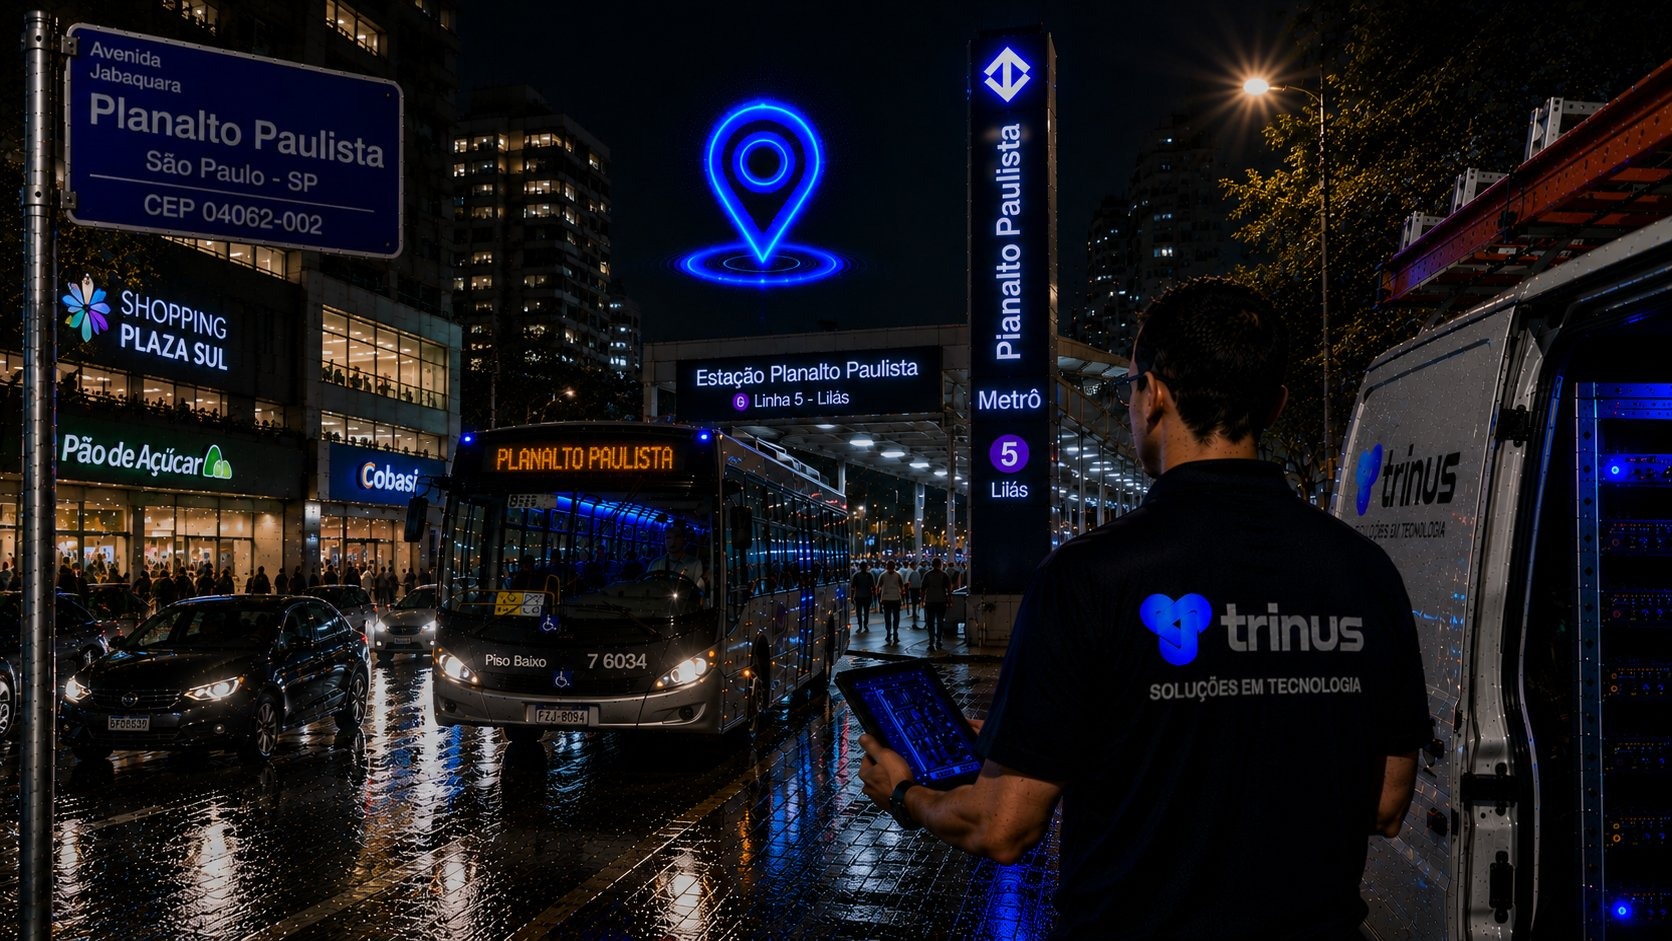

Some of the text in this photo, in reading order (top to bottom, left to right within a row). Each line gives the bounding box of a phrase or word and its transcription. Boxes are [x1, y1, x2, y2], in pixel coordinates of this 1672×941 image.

[91, 41, 162, 68] Avenida
[90, 64, 181, 93] Jabaquara
[90, 92, 385, 169] Planalto Paulista
[146, 150, 192, 175] São
[201, 158, 264, 186] Paulo
[288, 171, 318, 192] SP
[996, 123, 1021, 236] Paulista
[144, 194, 322, 234] CEP 04062-002
[121, 290, 227, 341] SHOPPING
[121, 324, 228, 371] PLAZA SUL
[696, 360, 919, 388] Estação Planalto Paulista
[754, 392, 791, 408] Linha
[795, 392, 804, 405] 5
[818, 390, 850, 405] Lilás
[978, 388, 1042, 410] Metrô
[61, 434, 106, 465] Pão
[108, 441, 135, 469] de
[497, 445, 674, 471] PLANALTO PAULISTA
[1001, 441, 1018, 467] 5
[362, 461, 419, 493] Cobasi
[1382, 443, 1461, 508] trinus
[1221, 602, 1365, 653] trinus
[485, 653, 547, 668] Piso Baixo
[587, 653, 648, 669] 7 6034
[1150, 677, 1362, 703] SOLUÇÕES EM TECNOLOGIA
